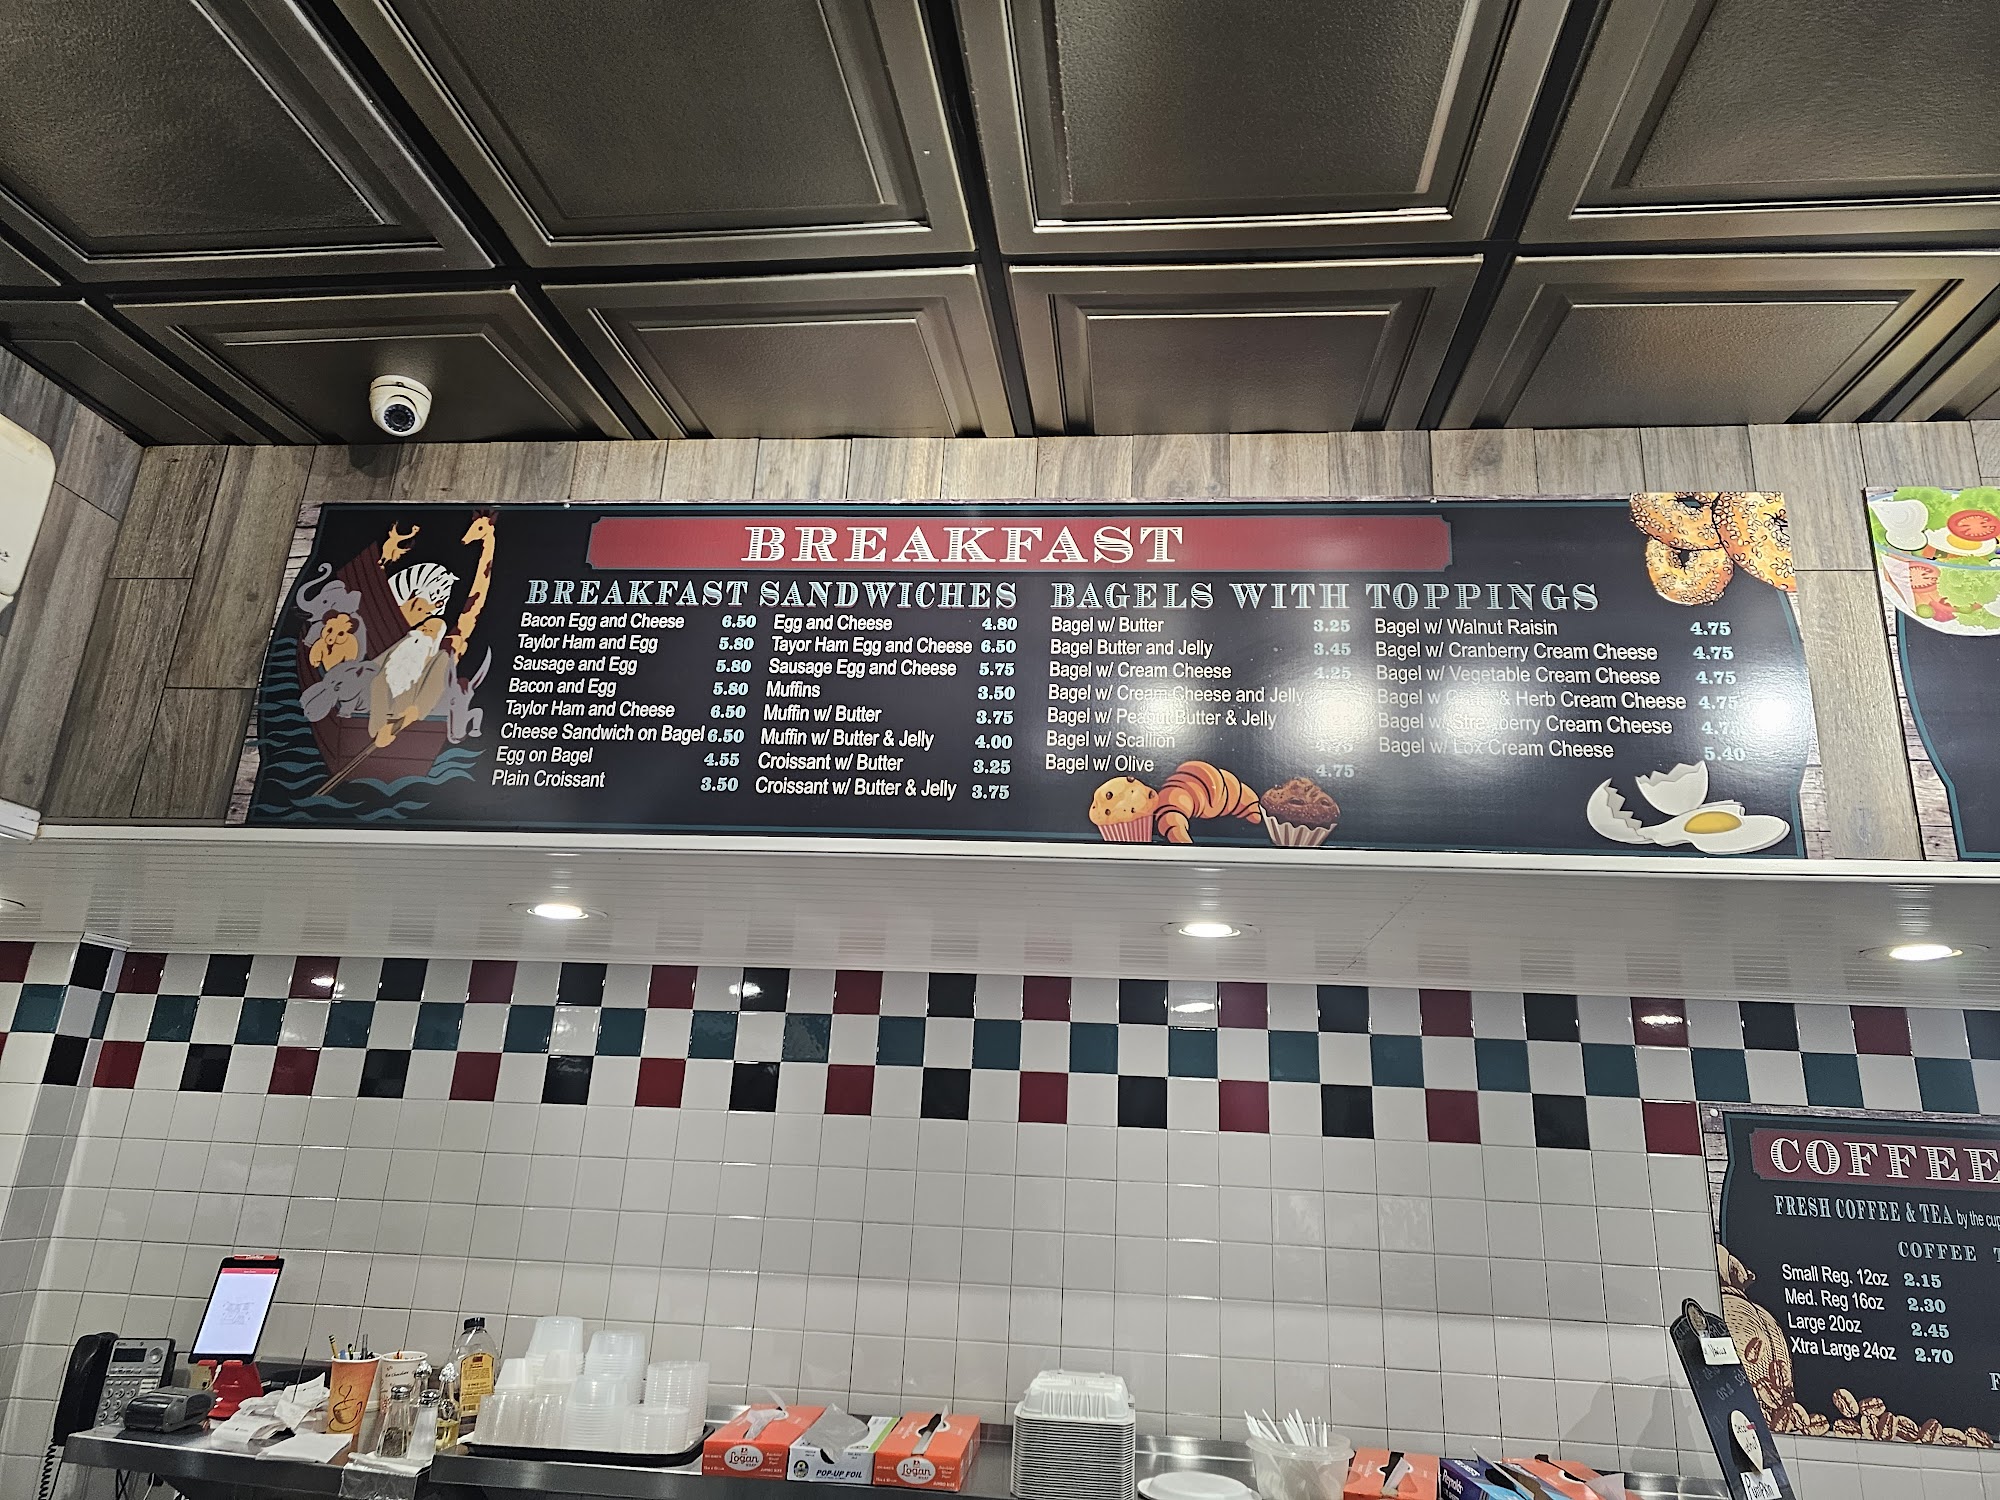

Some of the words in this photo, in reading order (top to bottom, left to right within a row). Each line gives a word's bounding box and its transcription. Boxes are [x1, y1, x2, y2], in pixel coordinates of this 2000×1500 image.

[741, 526, 1184, 563] BREAKFAST
[525, 580, 748, 606] BREAKFAST
[759, 581, 1017, 609] SANDWICHES
[1051, 583, 1214, 609] BAGELS
[1229, 583, 1350, 609] WITH
[1366, 583, 1599, 611] TOPPINGS
[521, 612, 564, 628] Bacon
[569, 612, 596, 631] Egg
[600, 613, 626, 628] and
[630, 613, 684, 628] Cheese
[721, 615, 756, 628] 6.50
[774, 614, 804, 632] Egg
[806, 615, 833, 630] and
[837, 615, 892, 631] Cheese
[981, 618, 1017, 630] 4.80
[1052, 617, 1094, 635] Bagel
[1098, 617, 1115, 632] w/
[1119, 617, 1164, 632] Butter
[1314, 620, 1350, 632] 3.25
[1375, 618, 1420, 637] Bagel
[1425, 619, 1443, 634] w/
[1447, 619, 1503, 635] Walnut
[1508, 619, 1557, 635] Raisin
[1690, 622, 1731, 636] 4.75
[517, 634, 560, 652] Taylor
[562, 635, 595, 649] Ham
[599, 635, 626, 650] and
[629, 635, 658, 653] Egg
[719, 637, 753, 650] 5.80
[772, 636, 811, 655] Tayor
[815, 636, 848, 652] Ham
[853, 637, 881, 656] Egg
[885, 637, 912, 653] and
[916, 638, 972, 654] Cheese
[980, 640, 1016, 653] 6.50
[1051, 639, 1093, 658] Bagel
[1097, 640, 1142, 654] Butter
[1146, 640, 1173, 655] and
[1178, 640, 1213, 659] Jelly
[1314, 643, 1351, 655] 3.45
[1376, 642, 1421, 660] Bagel
[1426, 642, 1444, 657] w/
[1449, 643, 1529, 661] Cranberry
[1534, 644, 1589, 659] Cream
[1593, 644, 1657, 660] Cheese
[1693, 646, 1733, 660] 4.75
[513, 655, 575, 674] Sausage
[578, 657, 605, 671] and
[608, 657, 637, 675] Egg
[716, 659, 751, 672] 5.80
[769, 658, 832, 678] Sausage
[836, 659, 865, 678] Egg
[869, 660, 897, 675] and
[900, 659, 957, 676] Cheese
[979, 663, 1014, 675] 5.75
[1050, 661, 1092, 681] Bagel
[1096, 662, 1113, 678] w/
[1118, 662, 1168, 678] Cream
[1173, 663, 1231, 678] Cheese
[1535, 667, 1590, 683] Cream
[1595, 668, 1660, 684] Cheese
[509, 678, 553, 693] Bacon
[557, 679, 584, 694] and
[587, 679, 616, 696] Egg
[713, 682, 748, 695] 5.80
[766, 681, 820, 697] Muffins
[977, 687, 1015, 700] 3.50
[1048, 684, 1091, 703] Bagel
[1095, 684, 1113, 699] w/
[1236, 686, 1265, 702] and
[506, 700, 548, 719] Taylor
[551, 701, 584, 716] Ham
[588, 701, 615, 716] and
[619, 701, 675, 717] Cheese
[710, 705, 745, 718] 6.50
[1561, 691, 1617, 708] Cream
[1621, 692, 1686, 709] Cheese
[764, 704, 810, 721] Muffin
[813, 705, 831, 721] w/
[835, 705, 882, 722] Butter
[976, 710, 1013, 724] 3.75
[1048, 707, 1090, 726] Bagel
[1095, 707, 1111, 723] w/
[501, 723, 557, 739] Cheese
[562, 724, 633, 740] Sandwich
[638, 726, 657, 741] on
[661, 725, 705, 745] Bagel
[707, 729, 744, 743] 6.50
[1546, 716, 1602, 733] Cream
[1606, 717, 1672, 735] Cheese
[761, 728, 807, 745] Muffin
[811, 729, 830, 745] w/
[833, 729, 880, 746] Butter
[883, 730, 894, 746] &
[898, 730, 934, 751] Jelly
[974, 735, 1013, 749] 4.00
[1046, 730, 1089, 750] Bagel
[1094, 731, 1111, 747] w/
[1548, 740, 1614, 758] Cheese
[496, 747, 525, 766] Egg
[529, 749, 547, 762] on
[551, 747, 593, 767] Bagel
[703, 753, 740, 766] 4.55
[758, 752, 830, 770] Croissant
[834, 753, 853, 770] w/
[856, 754, 904, 771] Butter
[973, 760, 1010, 774] 3.25
[1045, 754, 1089, 774] Bagel
[1093, 754, 1110, 771] w/
[1114, 755, 1154, 772] Olive
[1316, 765, 1355, 778] 4.75
[492, 770, 529, 786] Plain
[534, 770, 605, 788] Croissant
[700, 777, 738, 791] 3.50
[755, 776, 828, 794] Croissant
[832, 777, 851, 795] w/
[854, 778, 902, 795] Butter
[905, 779, 916, 796] &
[921, 779, 957, 800] Jelly
[971, 785, 1009, 799] 3.75
[1771, 1138, 2000, 1183] COFFEE
[1774, 1195, 1831, 1218] FRESH
[1836, 1197, 1900, 1222] COFFEE
[1905, 1202, 1915, 1222] &
[1919, 1203, 1953, 1225] TEA
[1957, 1209, 1968, 1228] by
[1969, 1211, 1984, 1226] the
[1898, 1241, 1977, 1261] COFFEE
[1782, 1264, 1819, 1282] Small
[1822, 1268, 1853, 1286] Reg.
[1857, 1269, 1889, 1287] 12oz
[1903, 1273, 1941, 1288] 2.15
[1785, 1288, 1817, 1307] Med.
[1821, 1291, 1848, 1311] Reg
[1852, 1293, 1884, 1310] 16oz
[1907, 1298, 1946, 1314] 2.30
[1788, 1312, 1825, 1333] Large
[1829, 1316, 1861, 1333] 20oz
[1911, 1323, 1949, 1339] 2.45
[1791, 1337, 1818, 1356] Xtra
[1822, 1339, 1859, 1360] Large
[1863, 1341, 1896, 1360] 24oz
[1915, 1348, 1953, 1364] 2.70
[729, 1451, 759, 1464] Logan
[816, 1469, 845, 1477] POP-UP
[845, 1471, 863, 1479] FOIL
[902, 1464, 931, 1477] Logan
[1442, 1469, 1464, 1495] Reynolds
